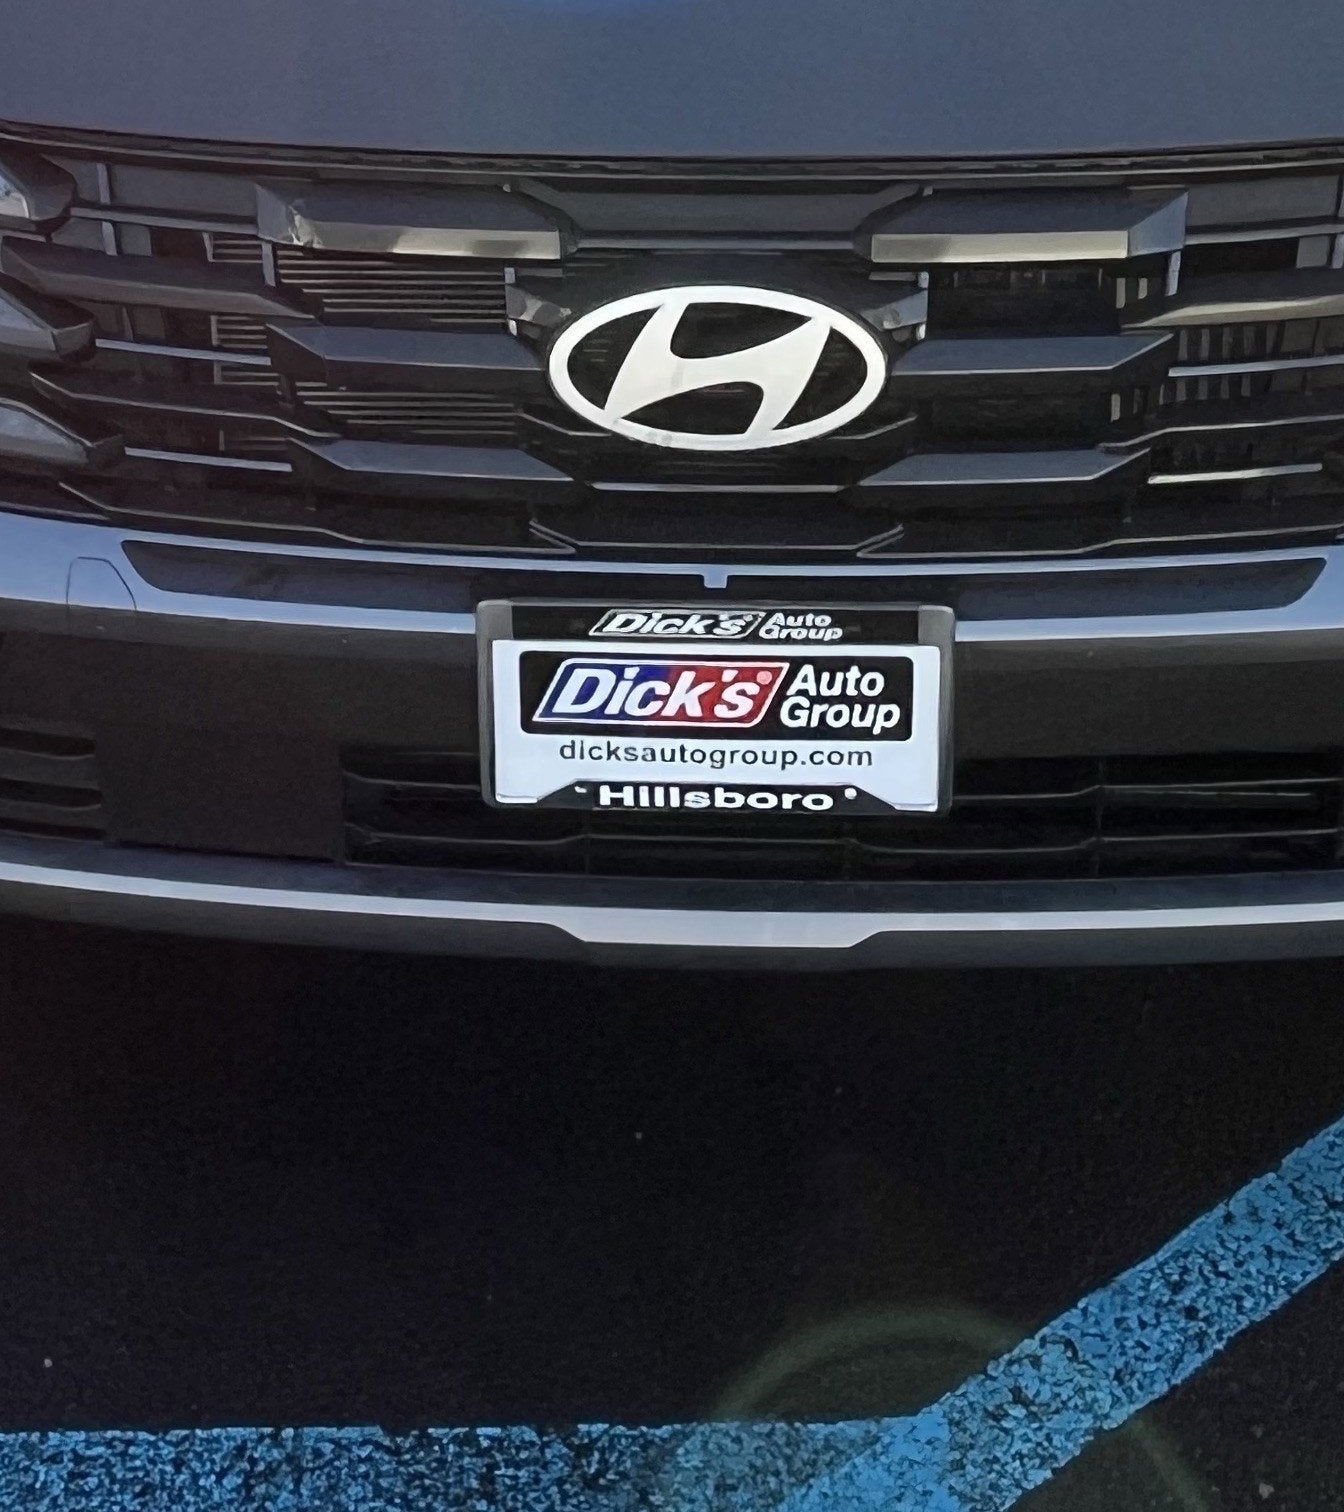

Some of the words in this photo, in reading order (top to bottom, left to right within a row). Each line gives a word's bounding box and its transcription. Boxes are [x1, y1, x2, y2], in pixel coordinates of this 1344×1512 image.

[602, 612, 746, 637] Dick's
[767, 612, 833, 627] Auto
[758, 625, 844, 641] Group
[554, 665, 761, 720] Dick's
[785, 664, 886, 698] Auto
[779, 699, 901, 735] Group
[559, 740, 874, 770] dicksautogroup.com
[598, 785, 835, 812] Hillsboro
